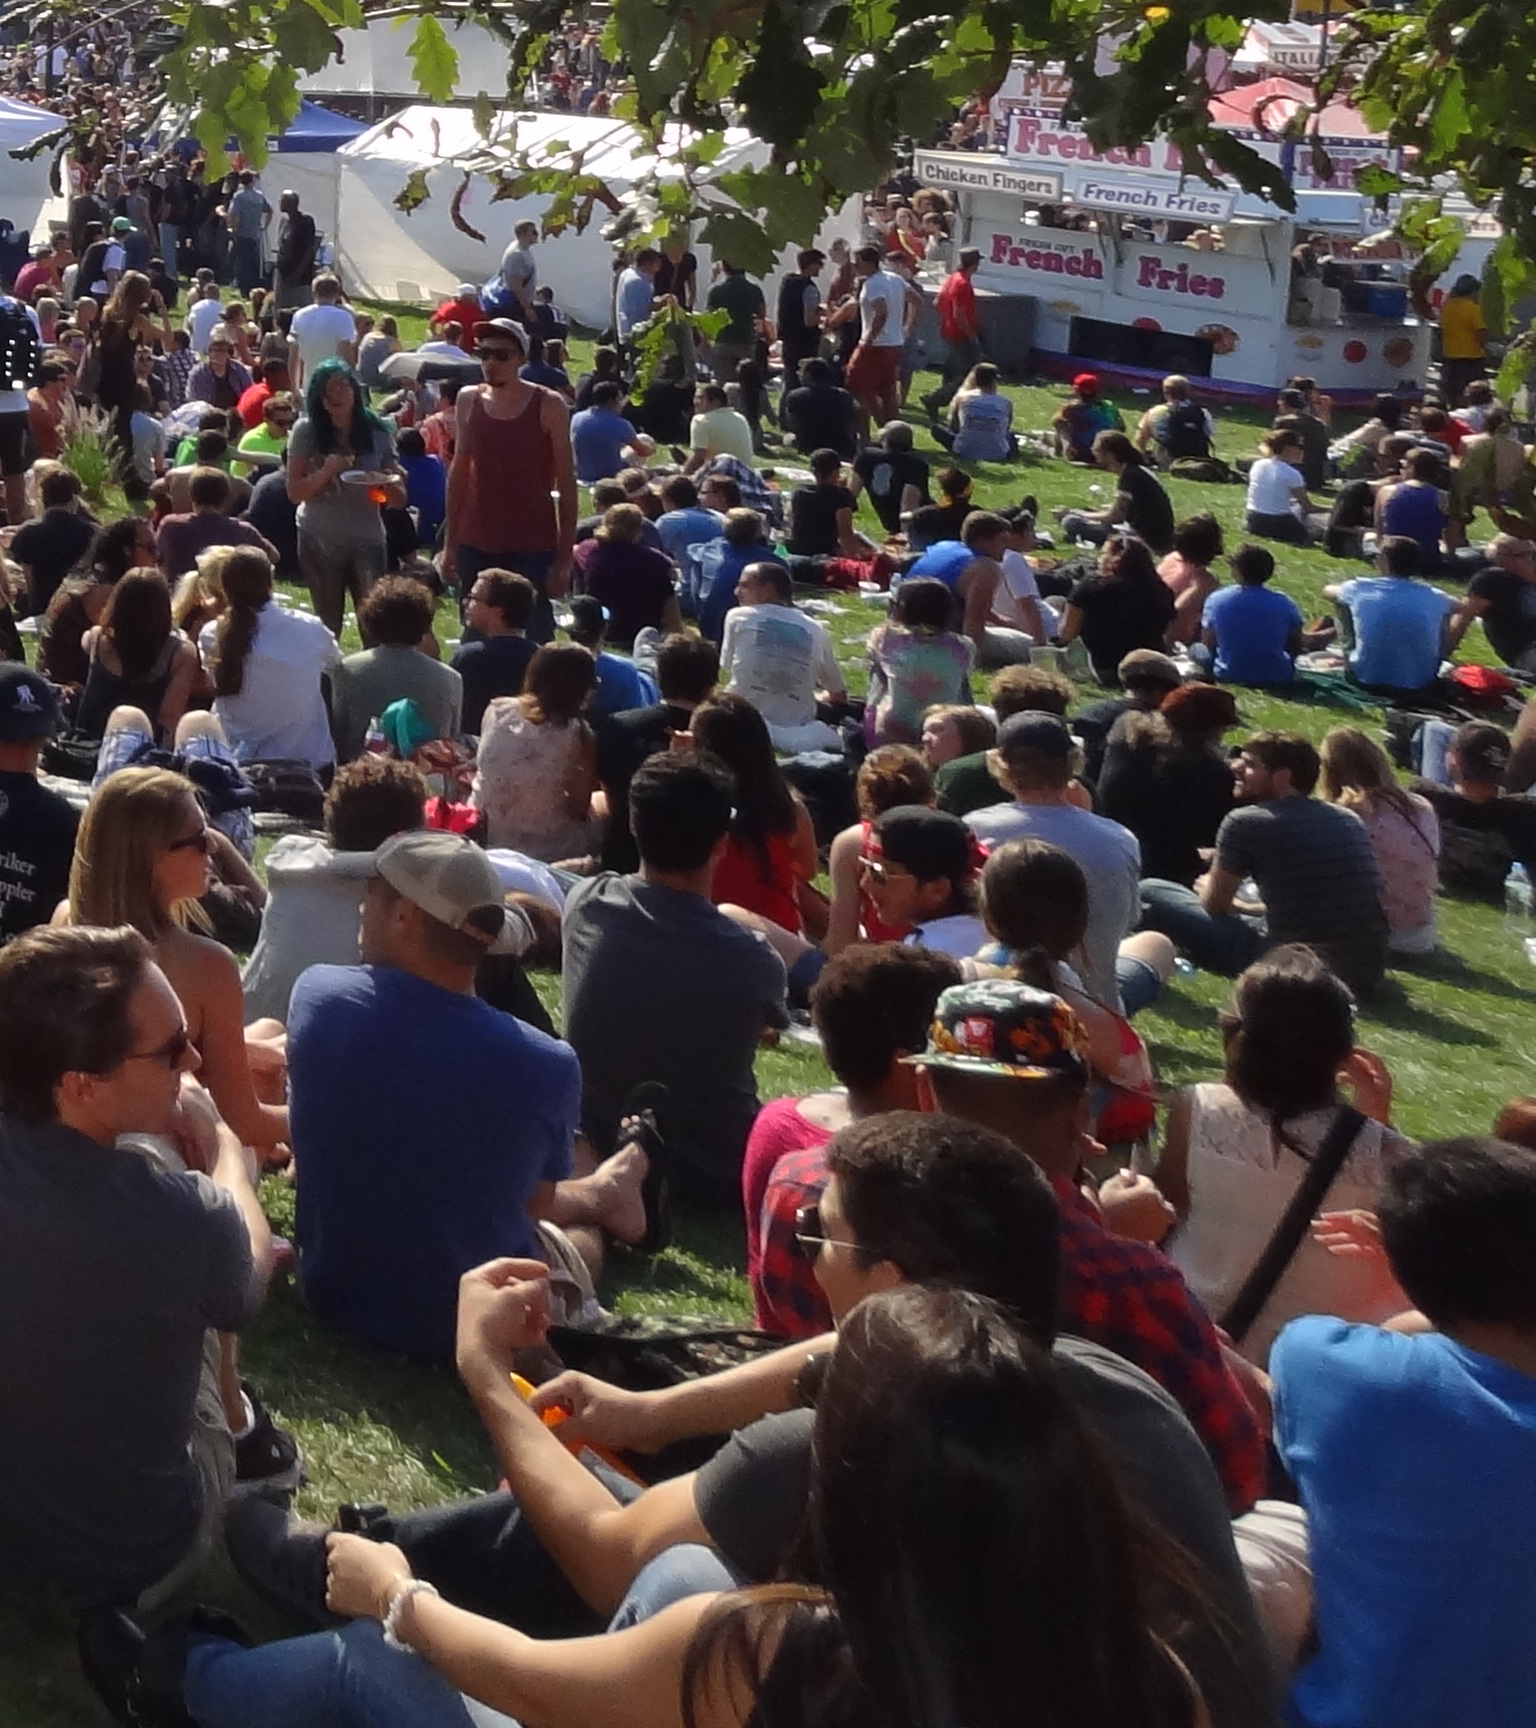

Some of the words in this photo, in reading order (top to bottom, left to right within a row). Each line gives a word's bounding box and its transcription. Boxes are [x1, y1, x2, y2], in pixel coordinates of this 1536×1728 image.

[925, 164, 989, 186] Chicken
[992, 174, 1054, 195] Fingers
[1083, 183, 1158, 208] French
[1165, 193, 1221, 216] Fries
[990, 233, 1104, 280] French
[1137, 255, 1226, 299] Fries
